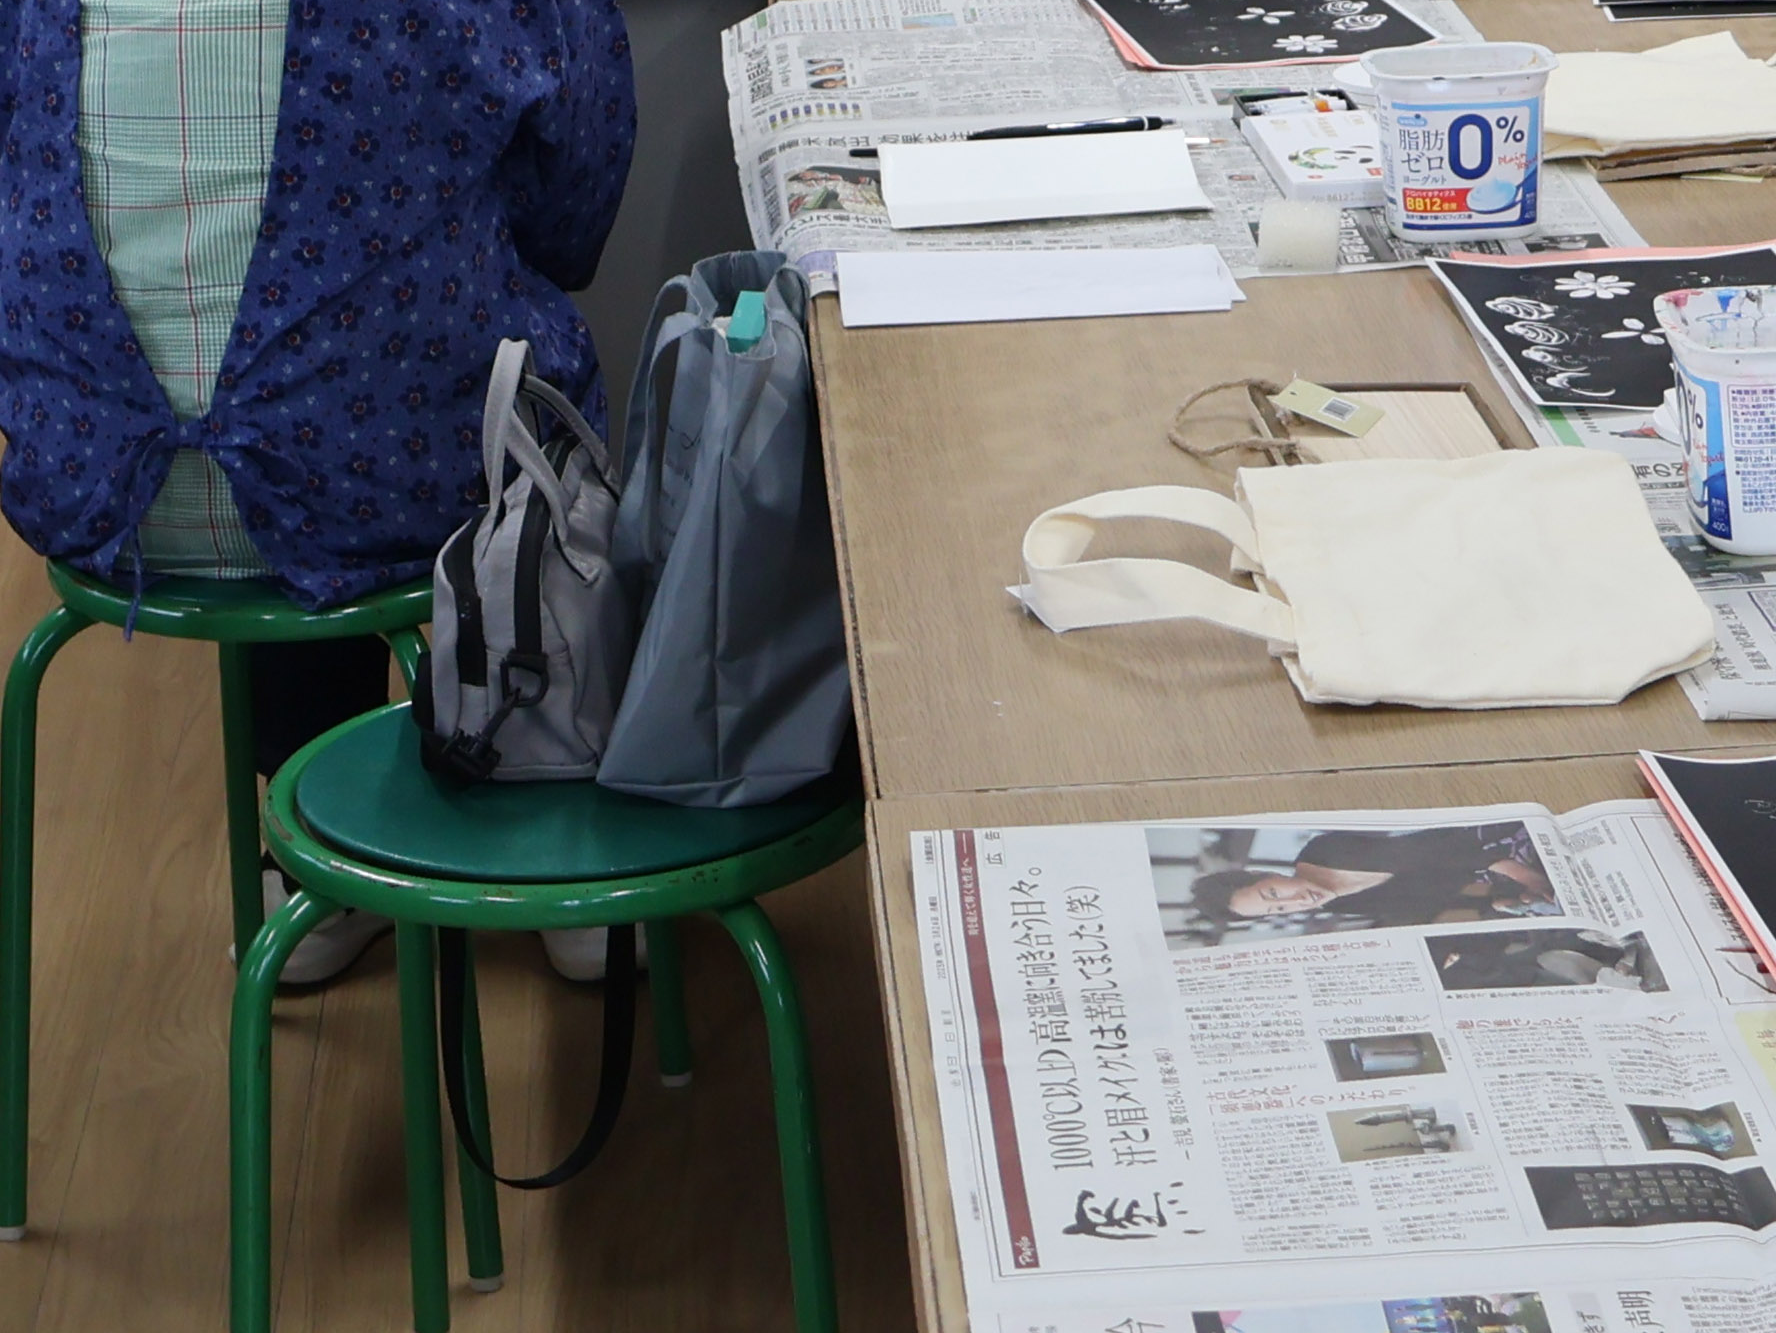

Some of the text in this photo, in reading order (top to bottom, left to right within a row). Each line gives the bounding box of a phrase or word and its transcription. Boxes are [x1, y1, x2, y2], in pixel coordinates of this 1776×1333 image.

[1399, 129, 1445, 151] 脂肪
[1401, 152, 1444, 173] ゼロ
[1403, 175, 1446, 186] ヨーグルト
